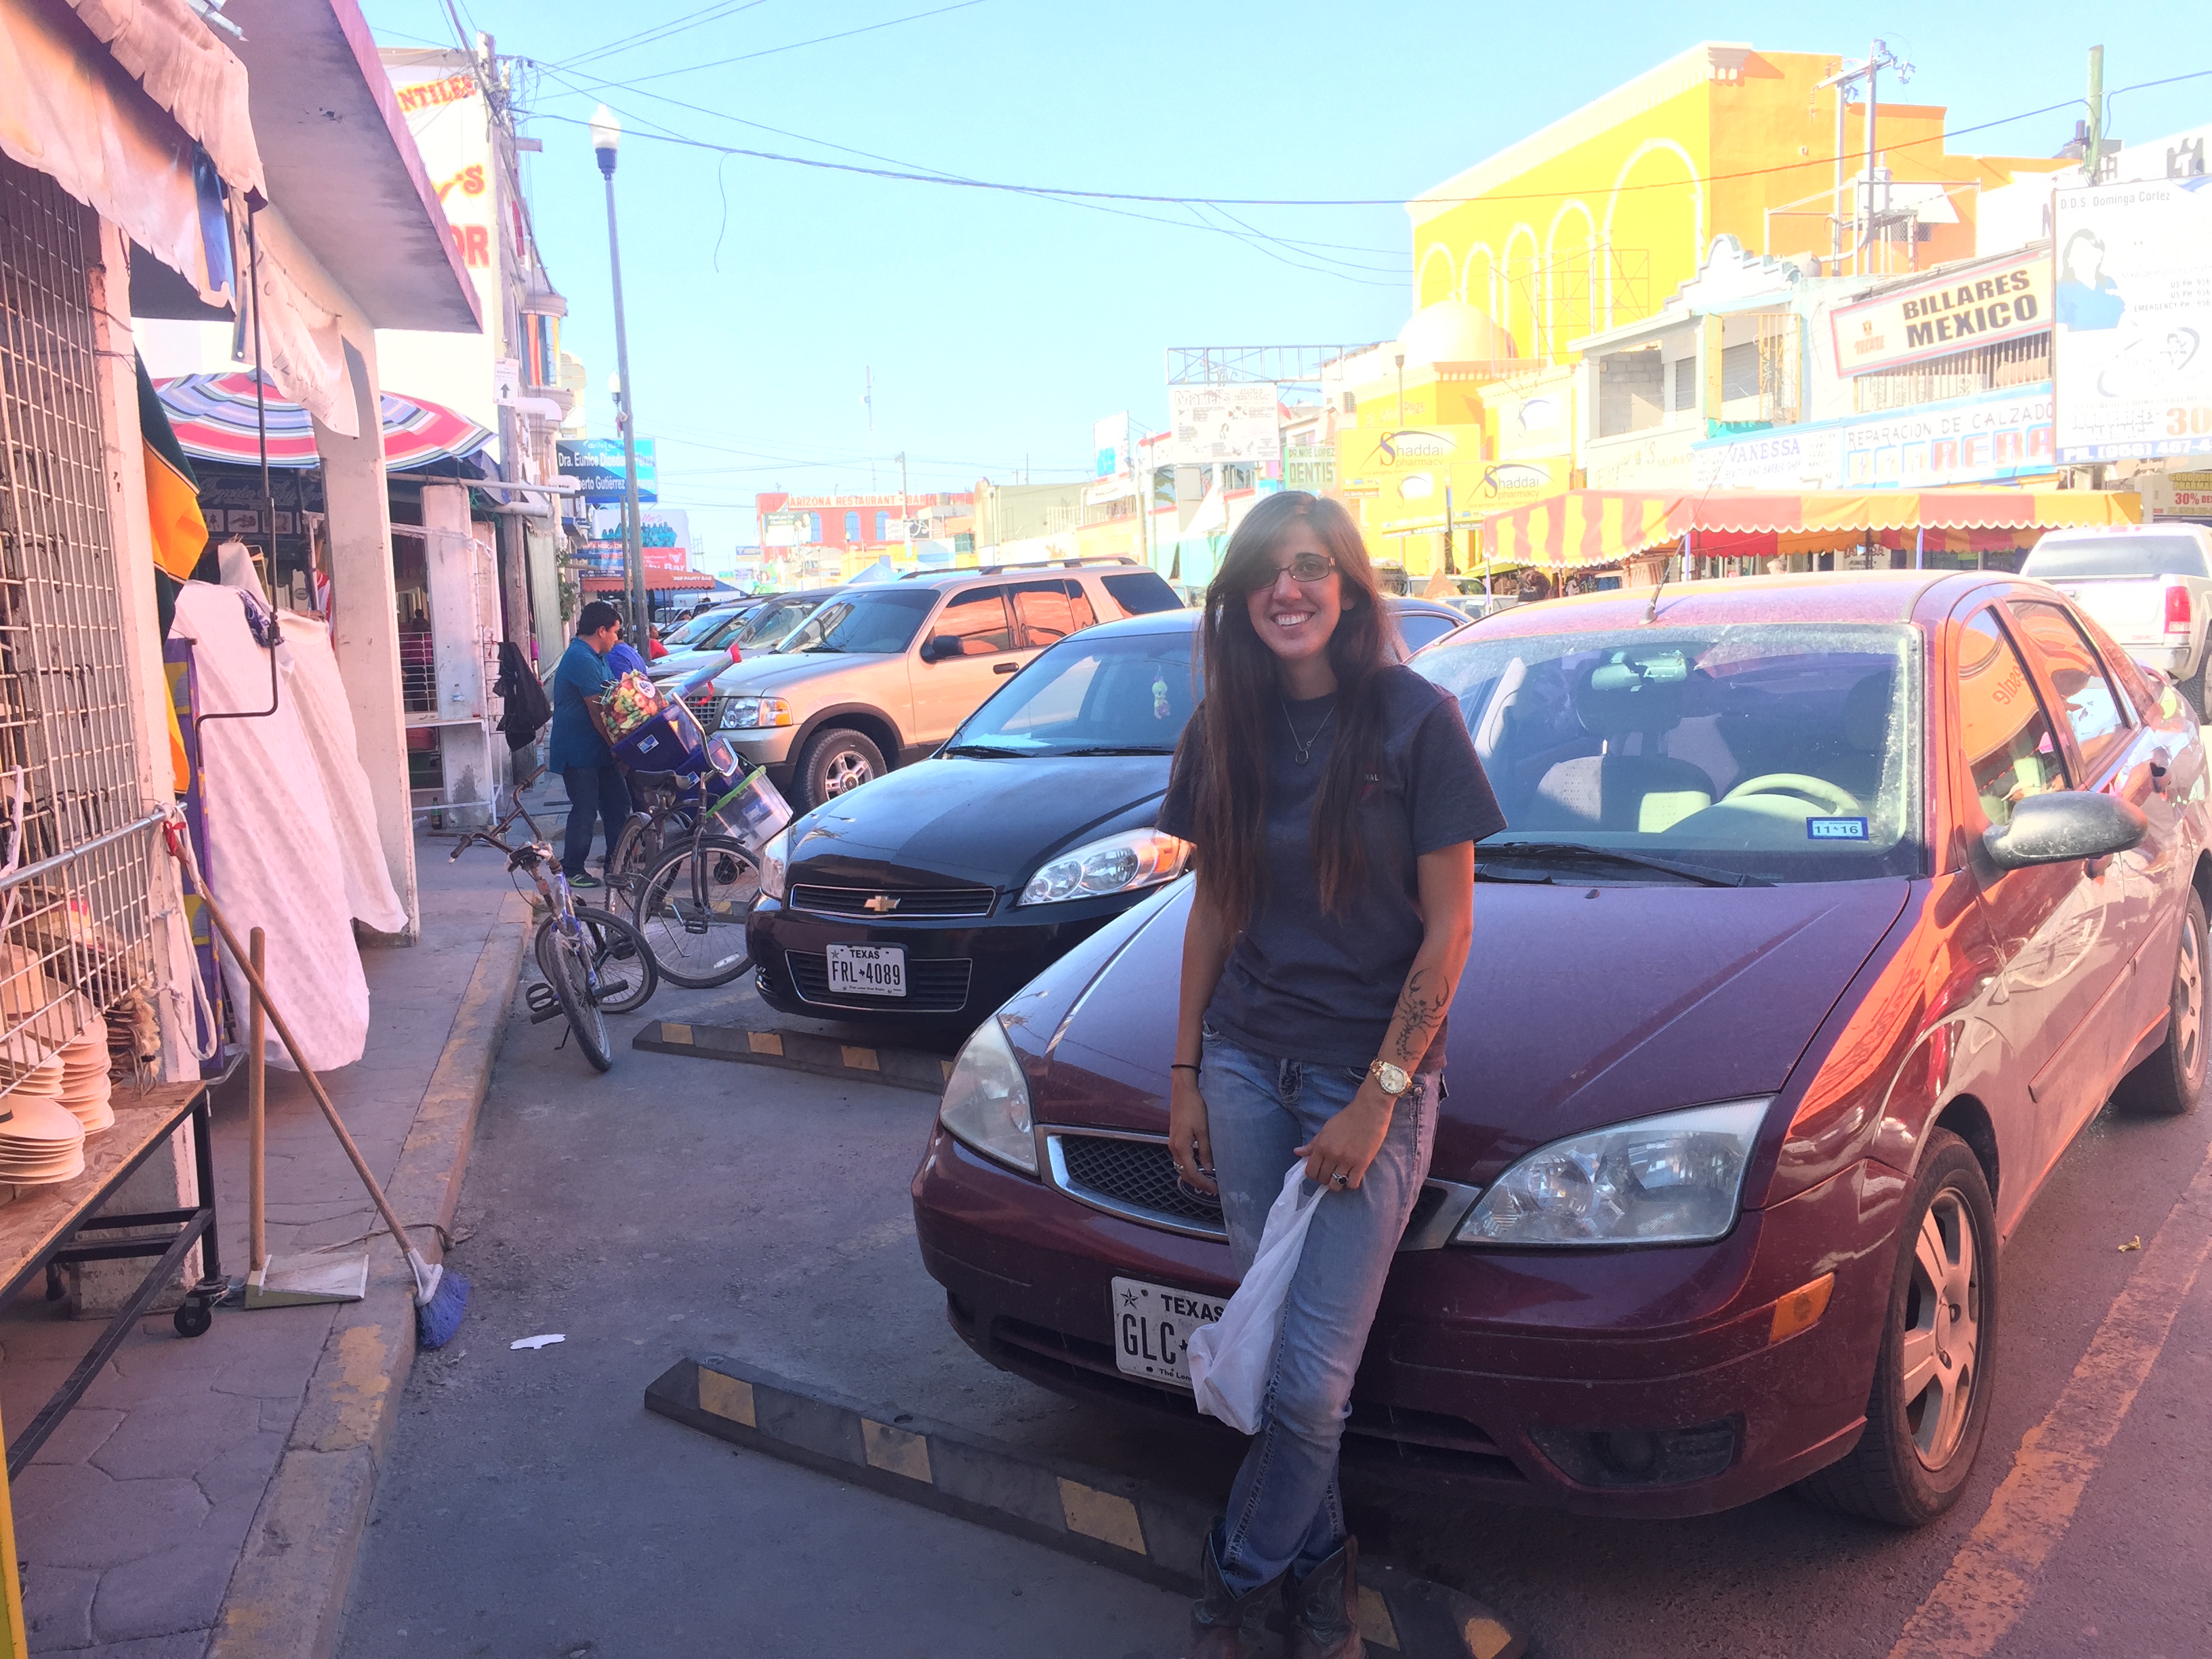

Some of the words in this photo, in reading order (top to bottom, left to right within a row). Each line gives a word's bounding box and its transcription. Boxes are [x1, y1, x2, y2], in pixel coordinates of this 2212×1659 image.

[394, 75, 476, 112] NTILES
[2093, 194, 2135, 206] Dominga
[2138, 190, 2171, 202] Cortez
[1903, 270, 2030, 321] BILLARES
[2134, 302, 2177, 312] EMERGENCY
[1906, 293, 2039, 348] MEXICO
[1848, 423, 1931, 451] REPARACION
[1941, 416, 1961, 434] DE
[1972, 402, 2053, 430] CALZADO
[1314, 447, 1335, 457] LOPEZ
[1380, 431, 1443, 467] Shaddai
[1729, 438, 1801, 463] VANESSA
[2097, 443, 2152, 459] (956)
[558, 453, 573, 467] Dra.
[574, 452, 599, 467] Eunice
[1290, 462, 1335, 483] DENTIS
[595, 475, 626, 490] Gutiérrez
[1485, 465, 1539, 499] Shaddai
[790, 496, 832, 507] ARIZONA
[836, 495, 895, 506] RESTAURANT
[907, 495, 924, 504] BAR
[1498, 491, 1539, 501] pharmacy
[2175, 493, 2200, 505] 30%
[1814, 825, 1830, 834] 11
[1841, 825, 1859, 834] 16
[849, 949, 880, 960] TEXAS
[1160, 1294, 1225, 1322] TEXAS
[1122, 1313, 1176, 1365] GLC
[1159, 1368, 1174, 1378] The
[1176, 1372, 1193, 1381] Lon
